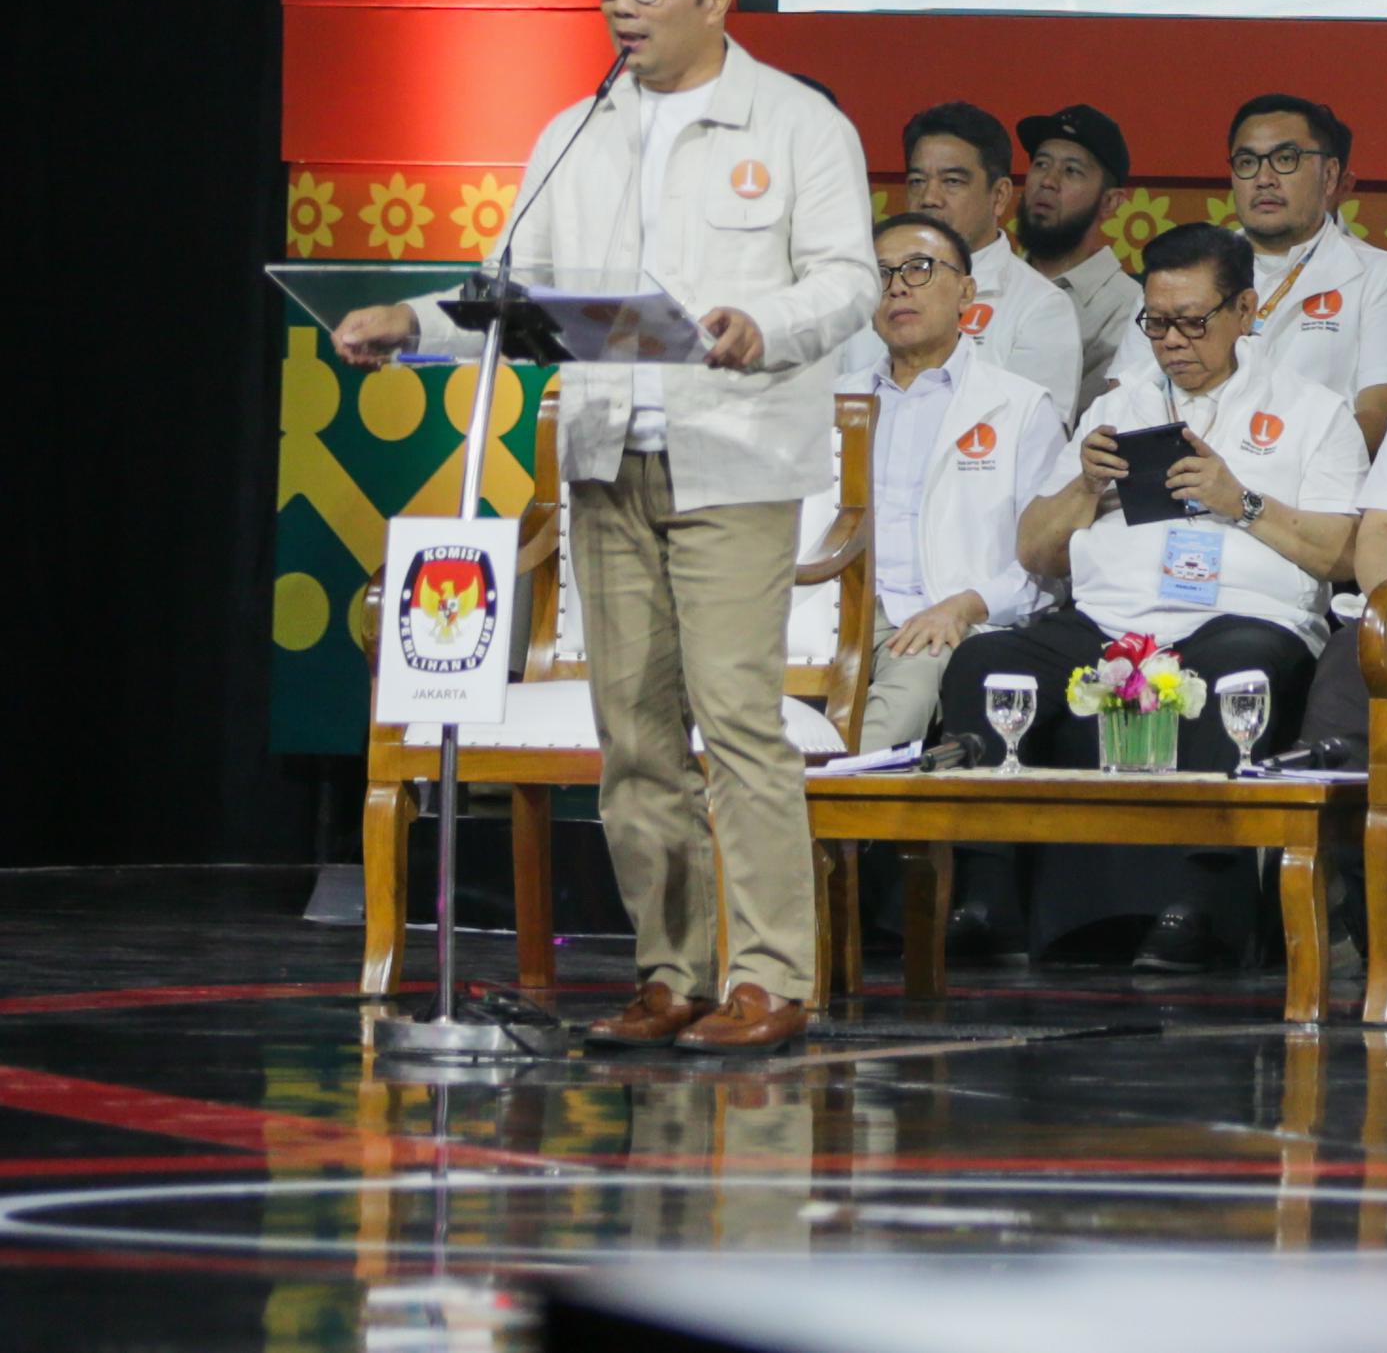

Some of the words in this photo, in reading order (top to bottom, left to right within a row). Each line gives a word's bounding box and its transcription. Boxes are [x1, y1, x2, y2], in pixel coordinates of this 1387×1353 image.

[423, 546, 482, 564] KOMISI
[400, 614, 463, 673] PEMILIHAN
[463, 614, 497, 671] UMUM
[412, 687, 468, 701] JAKARTA
